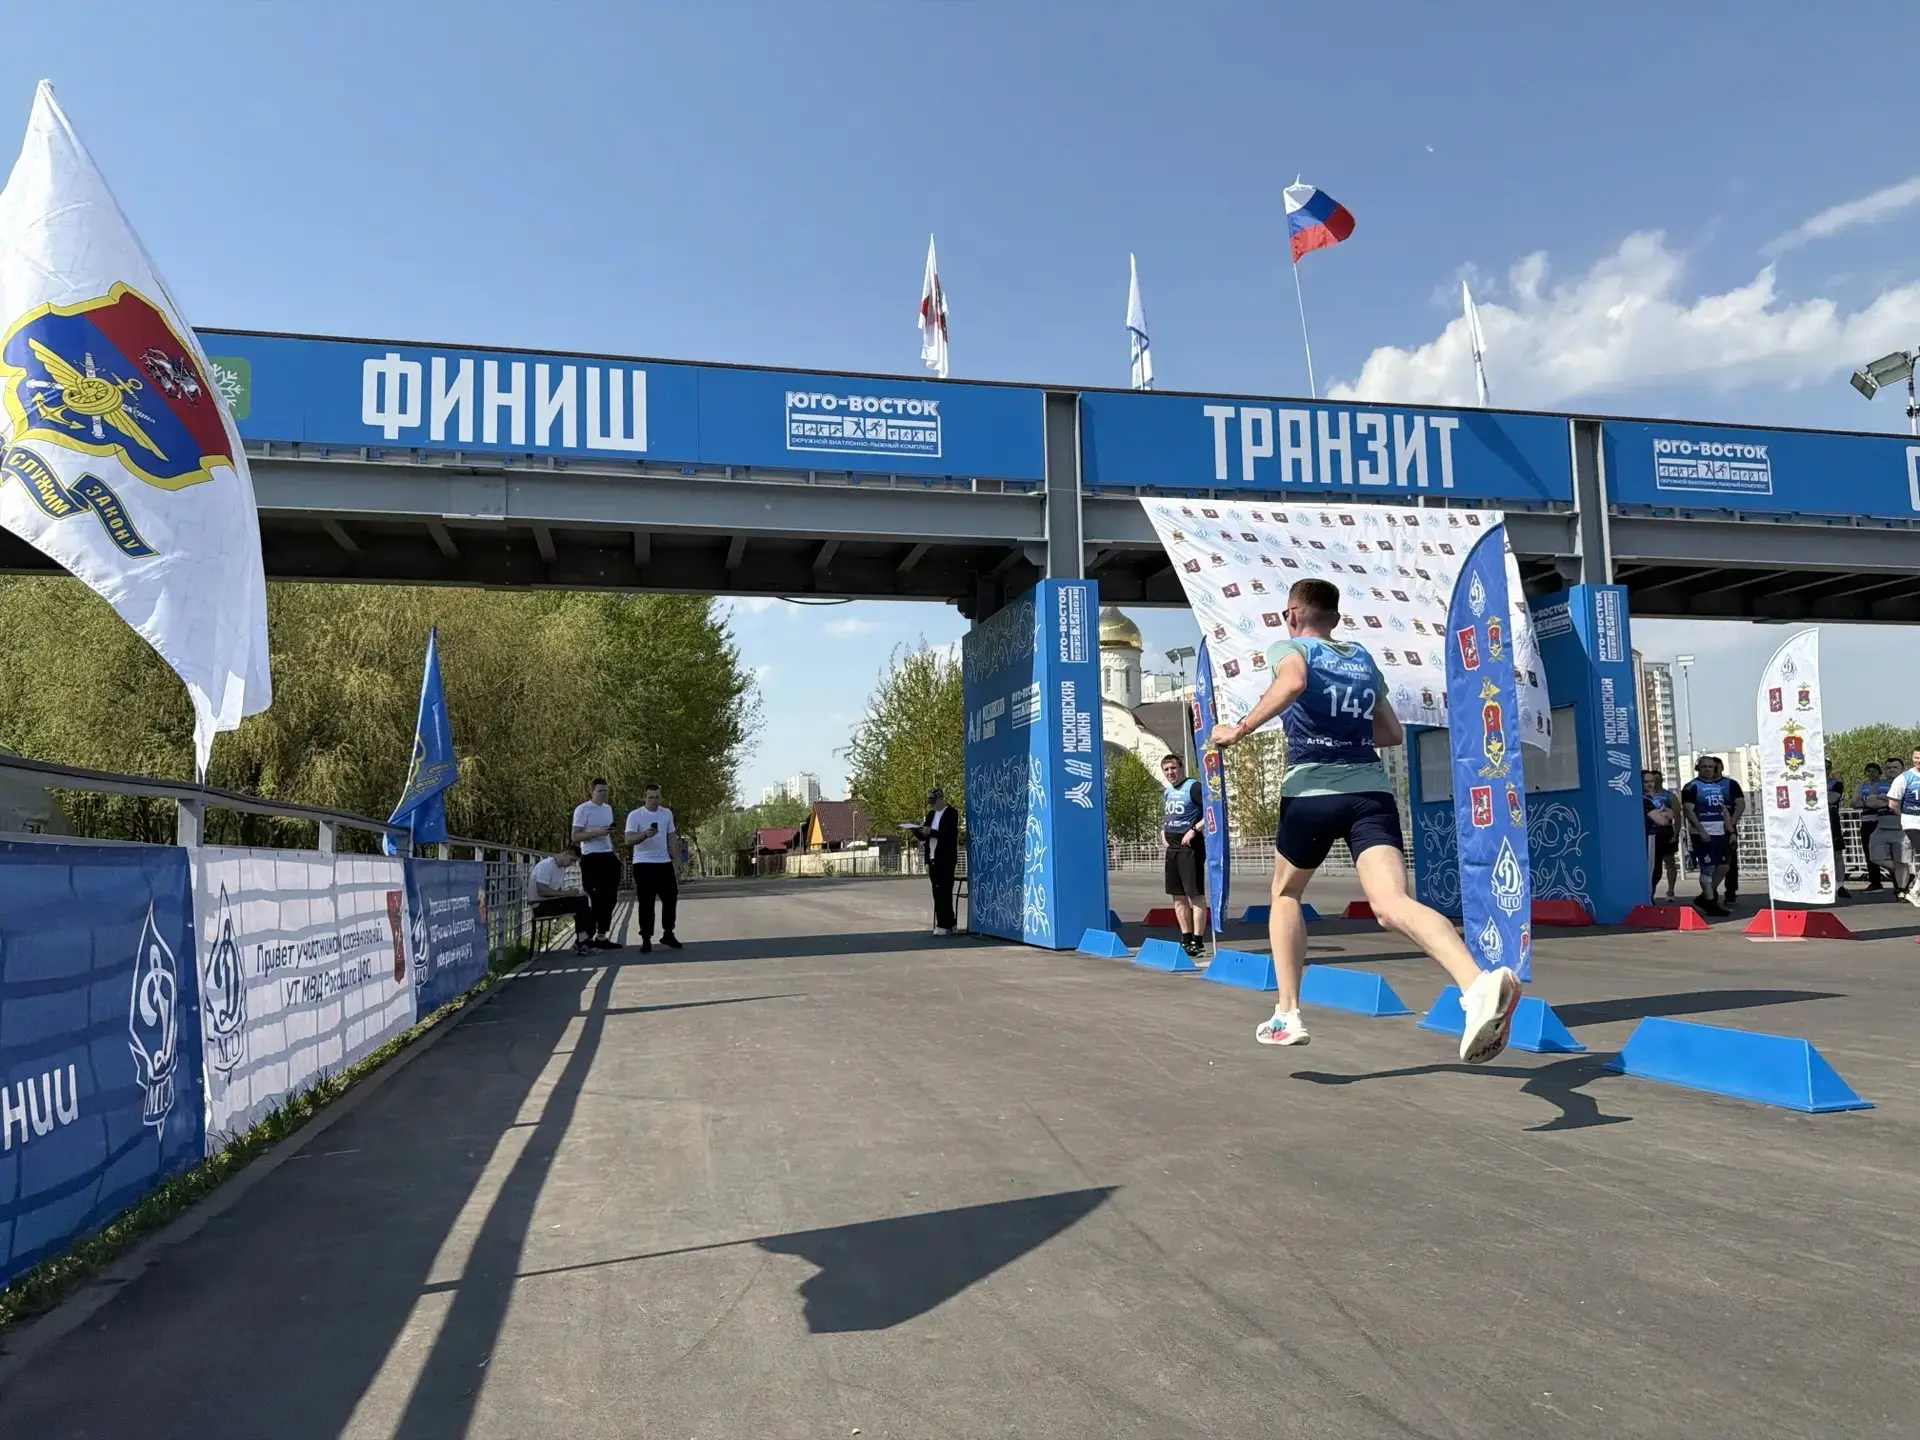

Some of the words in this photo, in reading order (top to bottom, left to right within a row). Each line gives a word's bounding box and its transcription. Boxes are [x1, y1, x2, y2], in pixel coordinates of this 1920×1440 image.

[362, 352, 648, 452] ФИНИШ
[785, 391, 940, 417] ЮГО-ВОСТОК
[791, 437, 828, 445] ОКРУЖНОЙ
[900, 443, 934, 451] КОМПЛЕКС
[1203, 405, 1460, 489] ТРАНЗИТ
[1653, 438, 1769, 460] ЮГО-ВОСТОК
[8, 453, 71, 515] СЛУЖИМ
[85, 485, 141, 549] ЗАКОНУ
[1058, 586, 1069, 663] ЮГО-ВОСТОК
[1595, 590, 1607, 661] ЮГО-ВОСТОК
[1061, 681, 1076, 753] МОСКОВСКАЯ
[1323, 685, 1376, 720] 142
[1601, 678, 1616, 744] МОСКОВСКАЯ
[1077, 712, 1091, 753] ЛЫЖНЯ
[1616, 707, 1630, 745] ЛЫЖНЯ
[1705, 794, 1725, 807] 155
[1500, 896, 1520, 909] МГО
[257, 943, 296, 978] Привет
[286, 979, 300, 1007] УТ
[302, 973, 323, 1003] МВД
